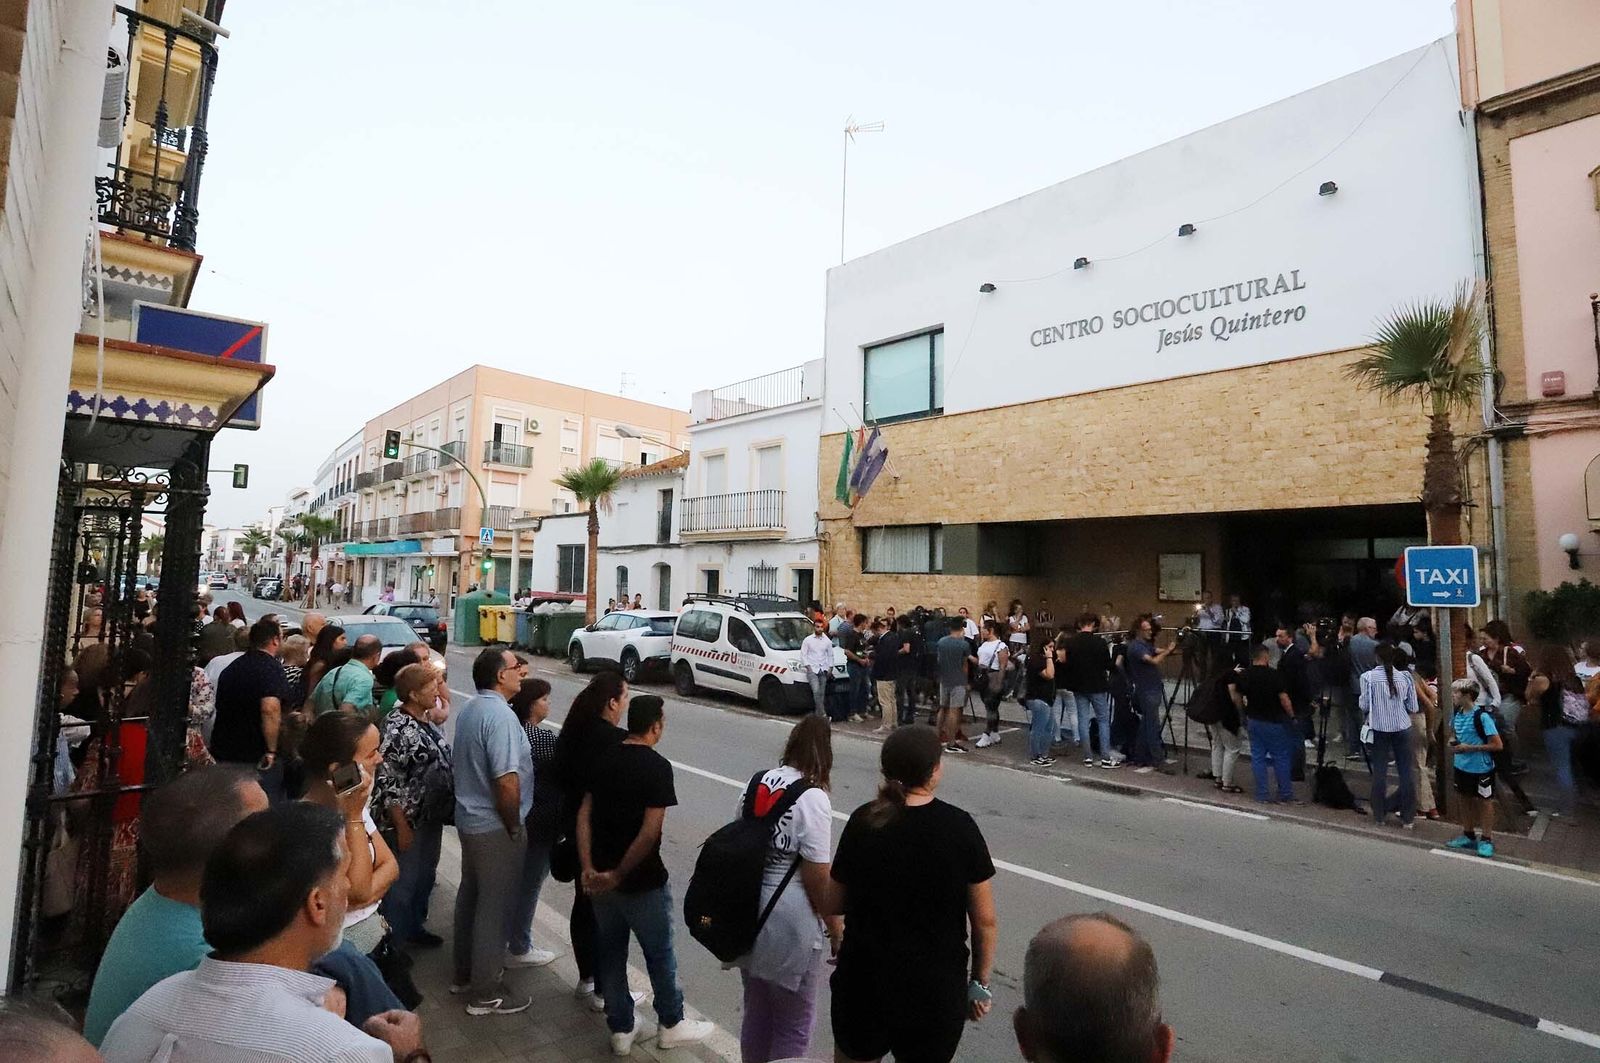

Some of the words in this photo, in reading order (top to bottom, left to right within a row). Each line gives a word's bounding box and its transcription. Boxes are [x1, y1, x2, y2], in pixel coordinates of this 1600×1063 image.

[1030, 315, 1104, 348] CENTRO
[1113, 269, 1307, 330] SOCIOCULTURAL
[1156, 324, 1203, 353] Jesús
[1209, 305, 1307, 341] Quintero
[1415, 568, 1469, 585] TAXI
